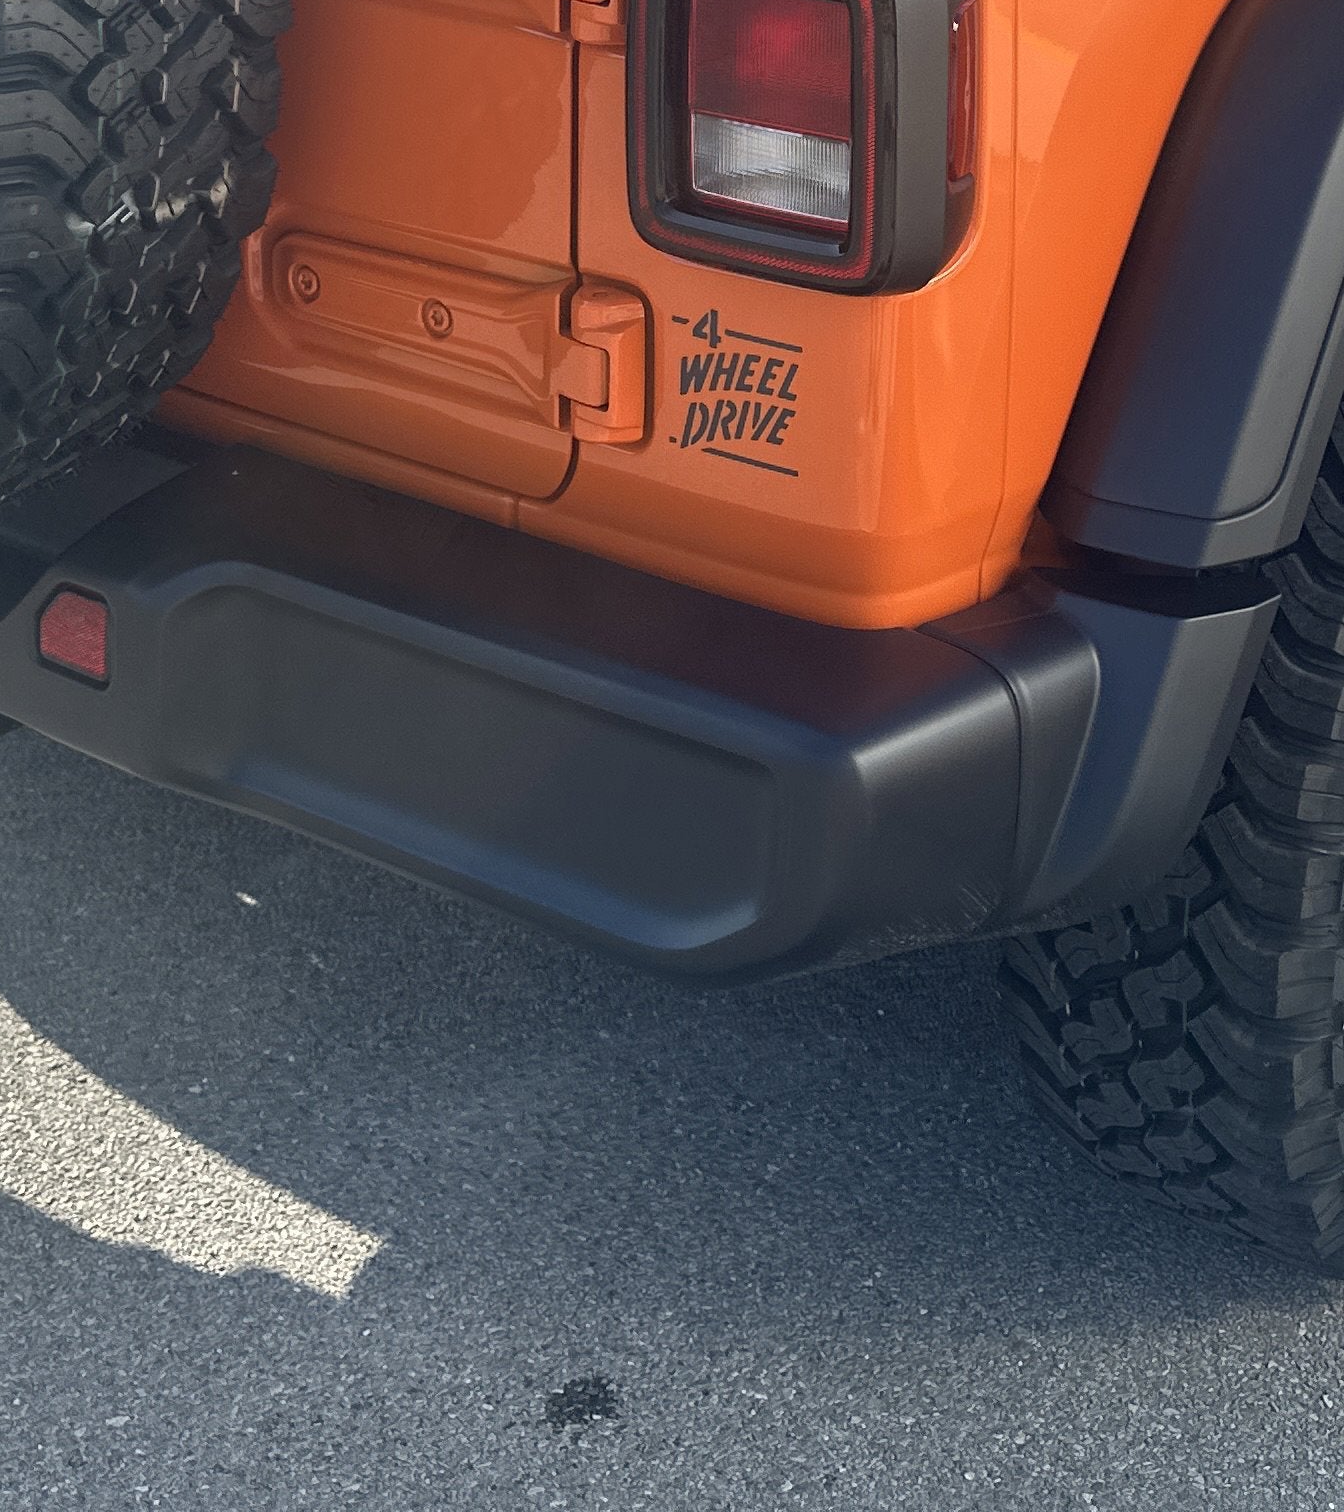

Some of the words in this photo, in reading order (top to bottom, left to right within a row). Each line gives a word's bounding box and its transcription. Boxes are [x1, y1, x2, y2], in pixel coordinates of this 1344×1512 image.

[692, 309, 722, 349] 4
[679, 352, 799, 401] WHEEL
[680, 399, 797, 449] DRIVE
